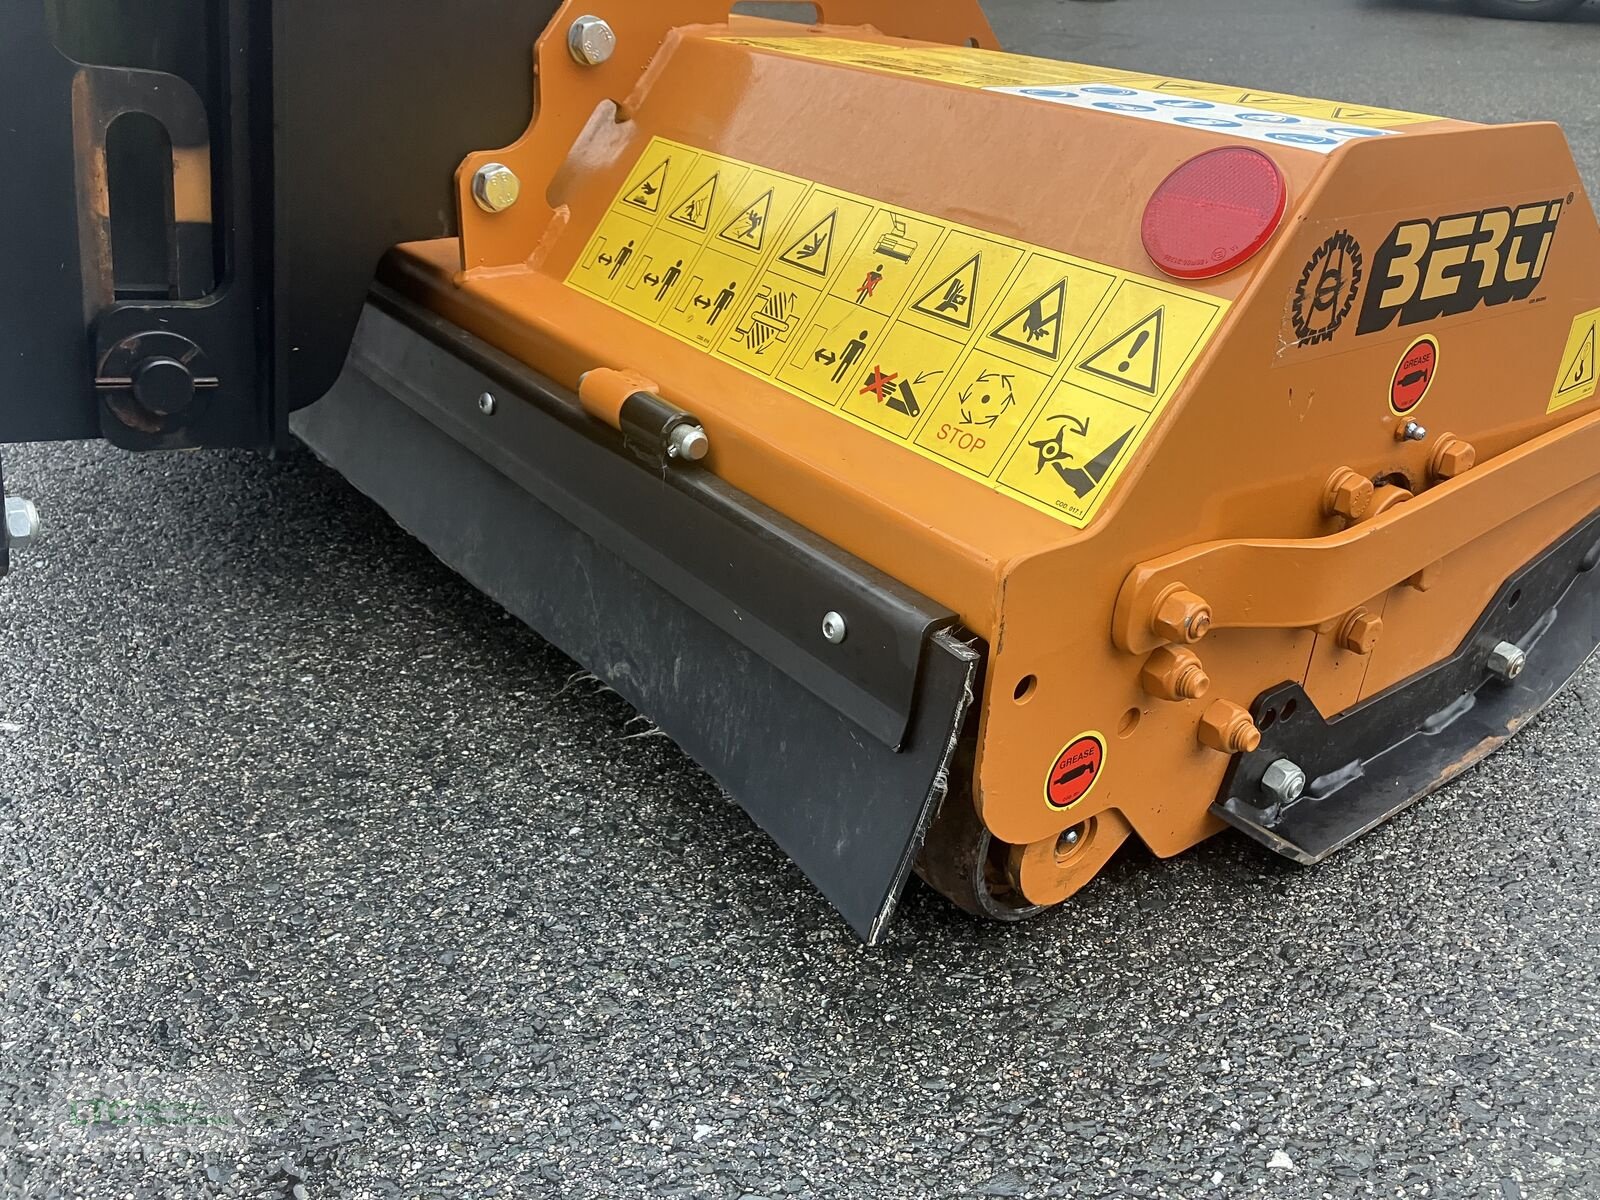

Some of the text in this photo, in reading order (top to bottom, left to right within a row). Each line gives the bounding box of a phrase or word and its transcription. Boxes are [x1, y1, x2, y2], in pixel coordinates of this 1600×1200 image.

[1403, 353, 1432, 370] GREASE
[937, 423, 986, 453] STOP
[1060, 746, 1095, 770] GREASE
